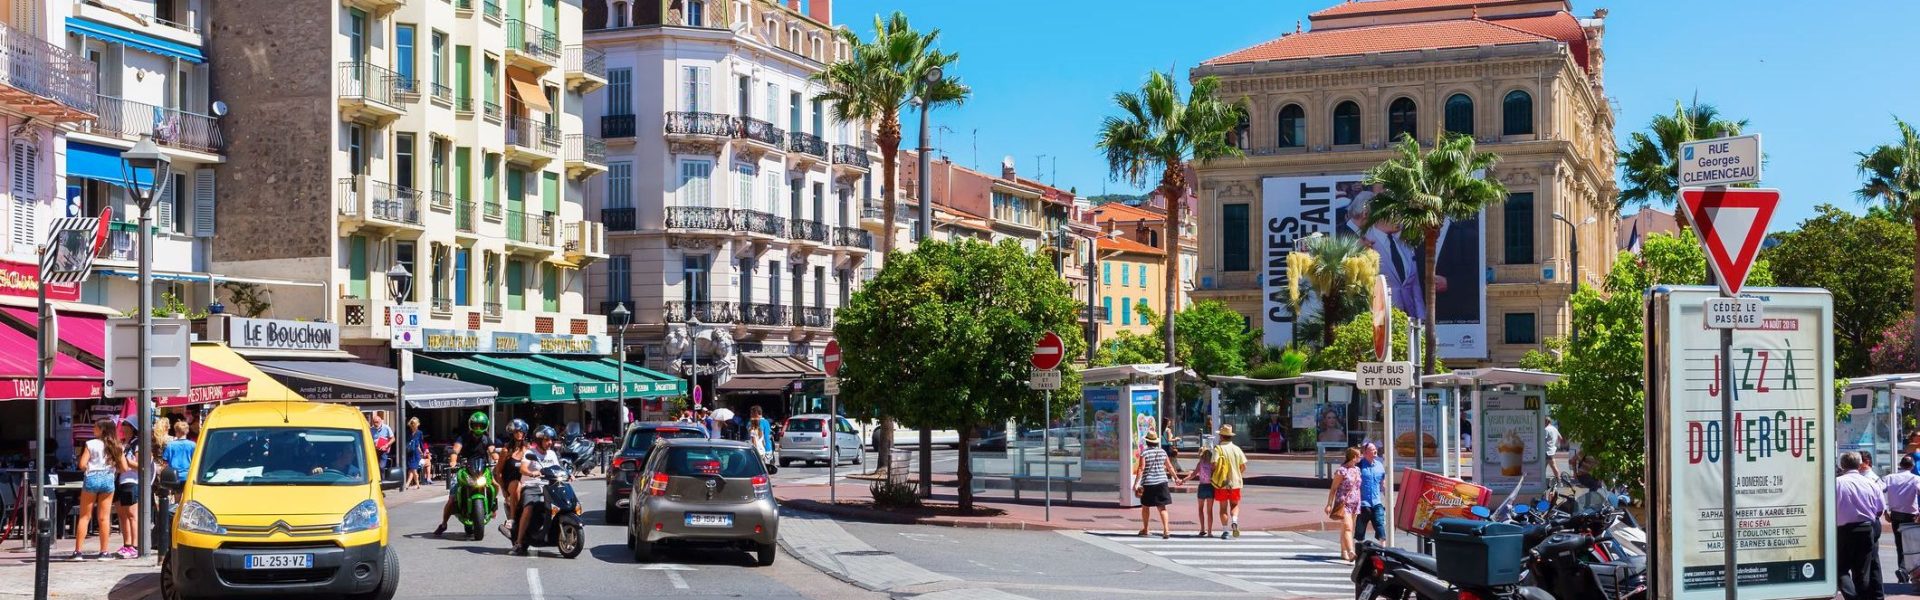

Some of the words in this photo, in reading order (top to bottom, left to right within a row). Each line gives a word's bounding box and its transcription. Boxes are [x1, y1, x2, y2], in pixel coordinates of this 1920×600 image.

[1708, 143, 1729, 154] RUE
[1698, 156, 1740, 167] Georges
[1683, 166, 1754, 182] CLEMENCEAU
[1268, 216, 1299, 323] CANNES
[1713, 302, 1741, 312] CÉDEZ
[1746, 303, 1757, 312] LE
[1715, 315, 1754, 323] PASSAGE
[246, 320, 262, 341] LE
[1362, 365, 1384, 374] SAUF
[1386, 365, 1404, 374] BUS
[1709, 347, 1770, 401] JZZ
[1782, 338, 1797, 390] À
[1364, 377, 1376, 386] ET
[1377, 377, 1402, 386] TAXIS
[188, 386, 223, 402] RESTAURANT
[1765, 507, 1784, 516] KAROL
[1786, 505, 1805, 515] BEFFA
[1743, 528, 1780, 538] COULONDRE
[1740, 539, 1766, 548] BARNES
[252, 556, 305, 567] DL-253-VZ
